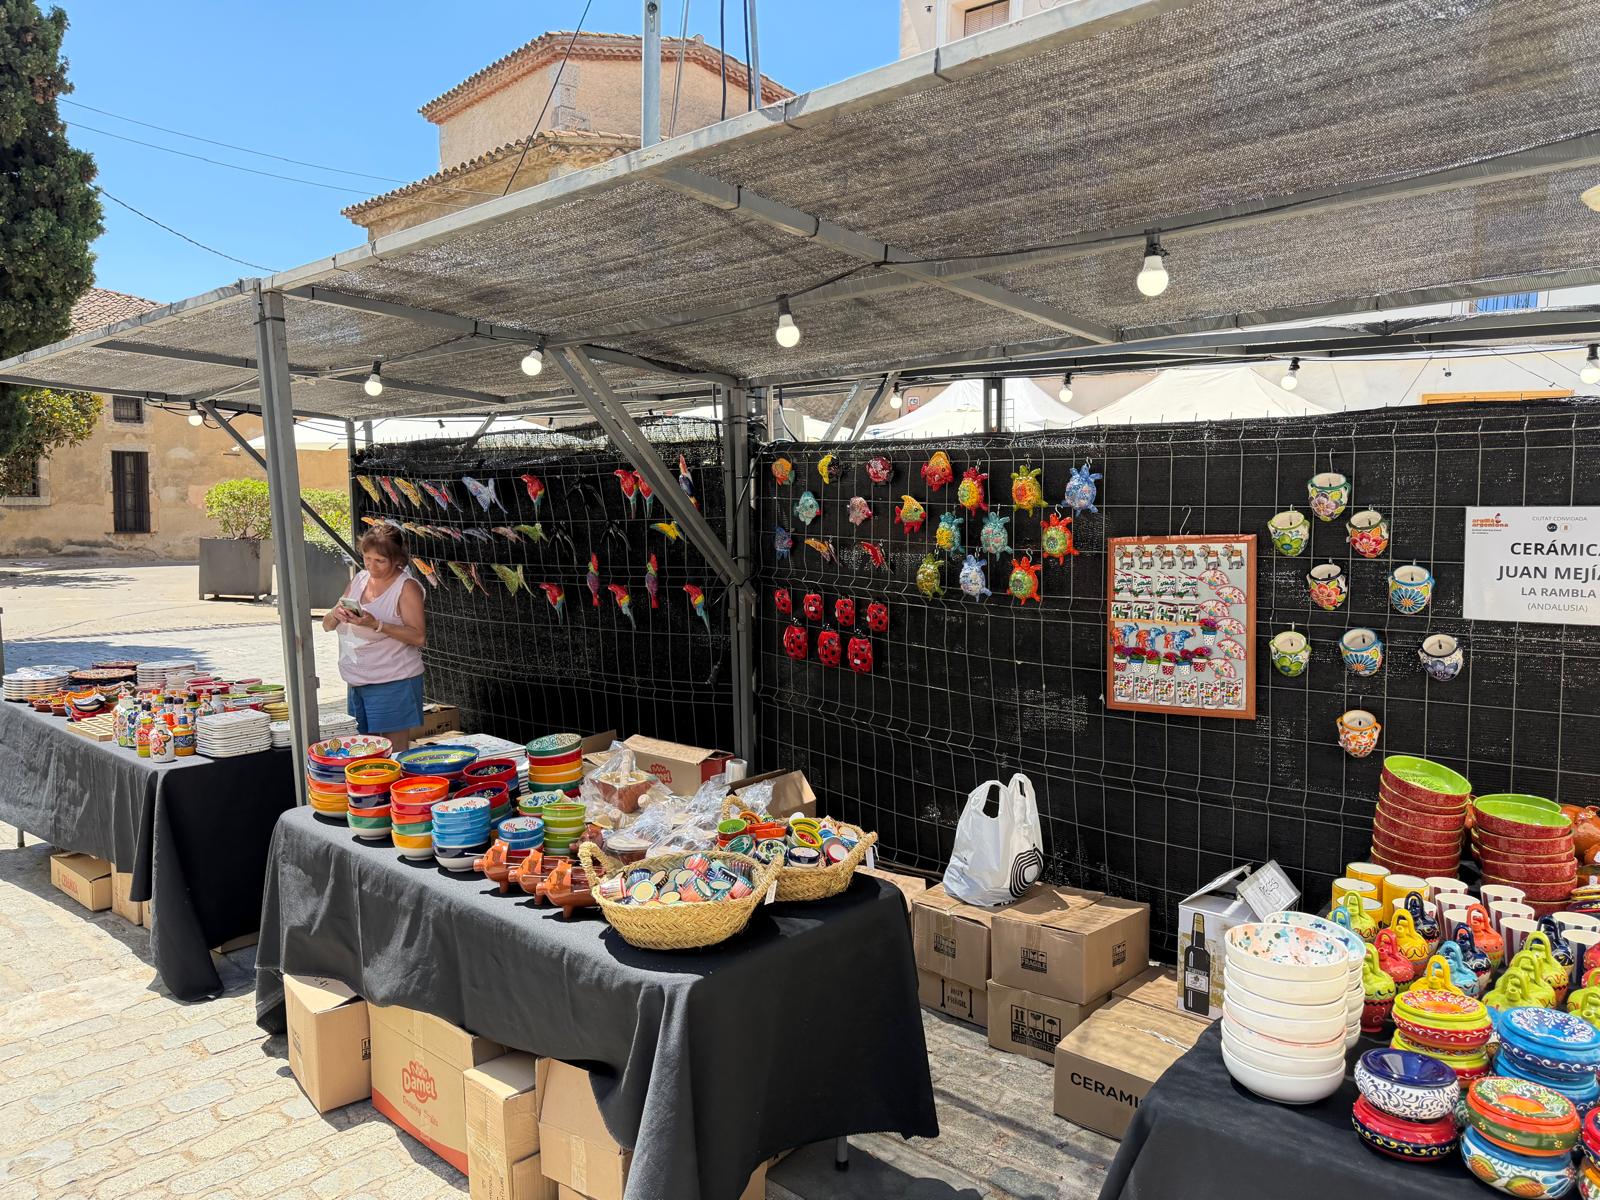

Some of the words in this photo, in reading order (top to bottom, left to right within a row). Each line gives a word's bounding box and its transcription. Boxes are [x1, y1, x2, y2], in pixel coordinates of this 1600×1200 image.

[1496, 565, 1547, 581] JUAN
[1521, 587, 1537, 596] LA
[1541, 588, 1597, 599] RAMBLA
[1527, 602, 1588, 613] (ANDALUSIA)
[1022, 958, 1046, 969] FRAGILE
[1012, 1023, 1060, 1045] FRAGILE
[402, 1068, 438, 1100] Damel
[1071, 1072, 1142, 1108] CERAMI
